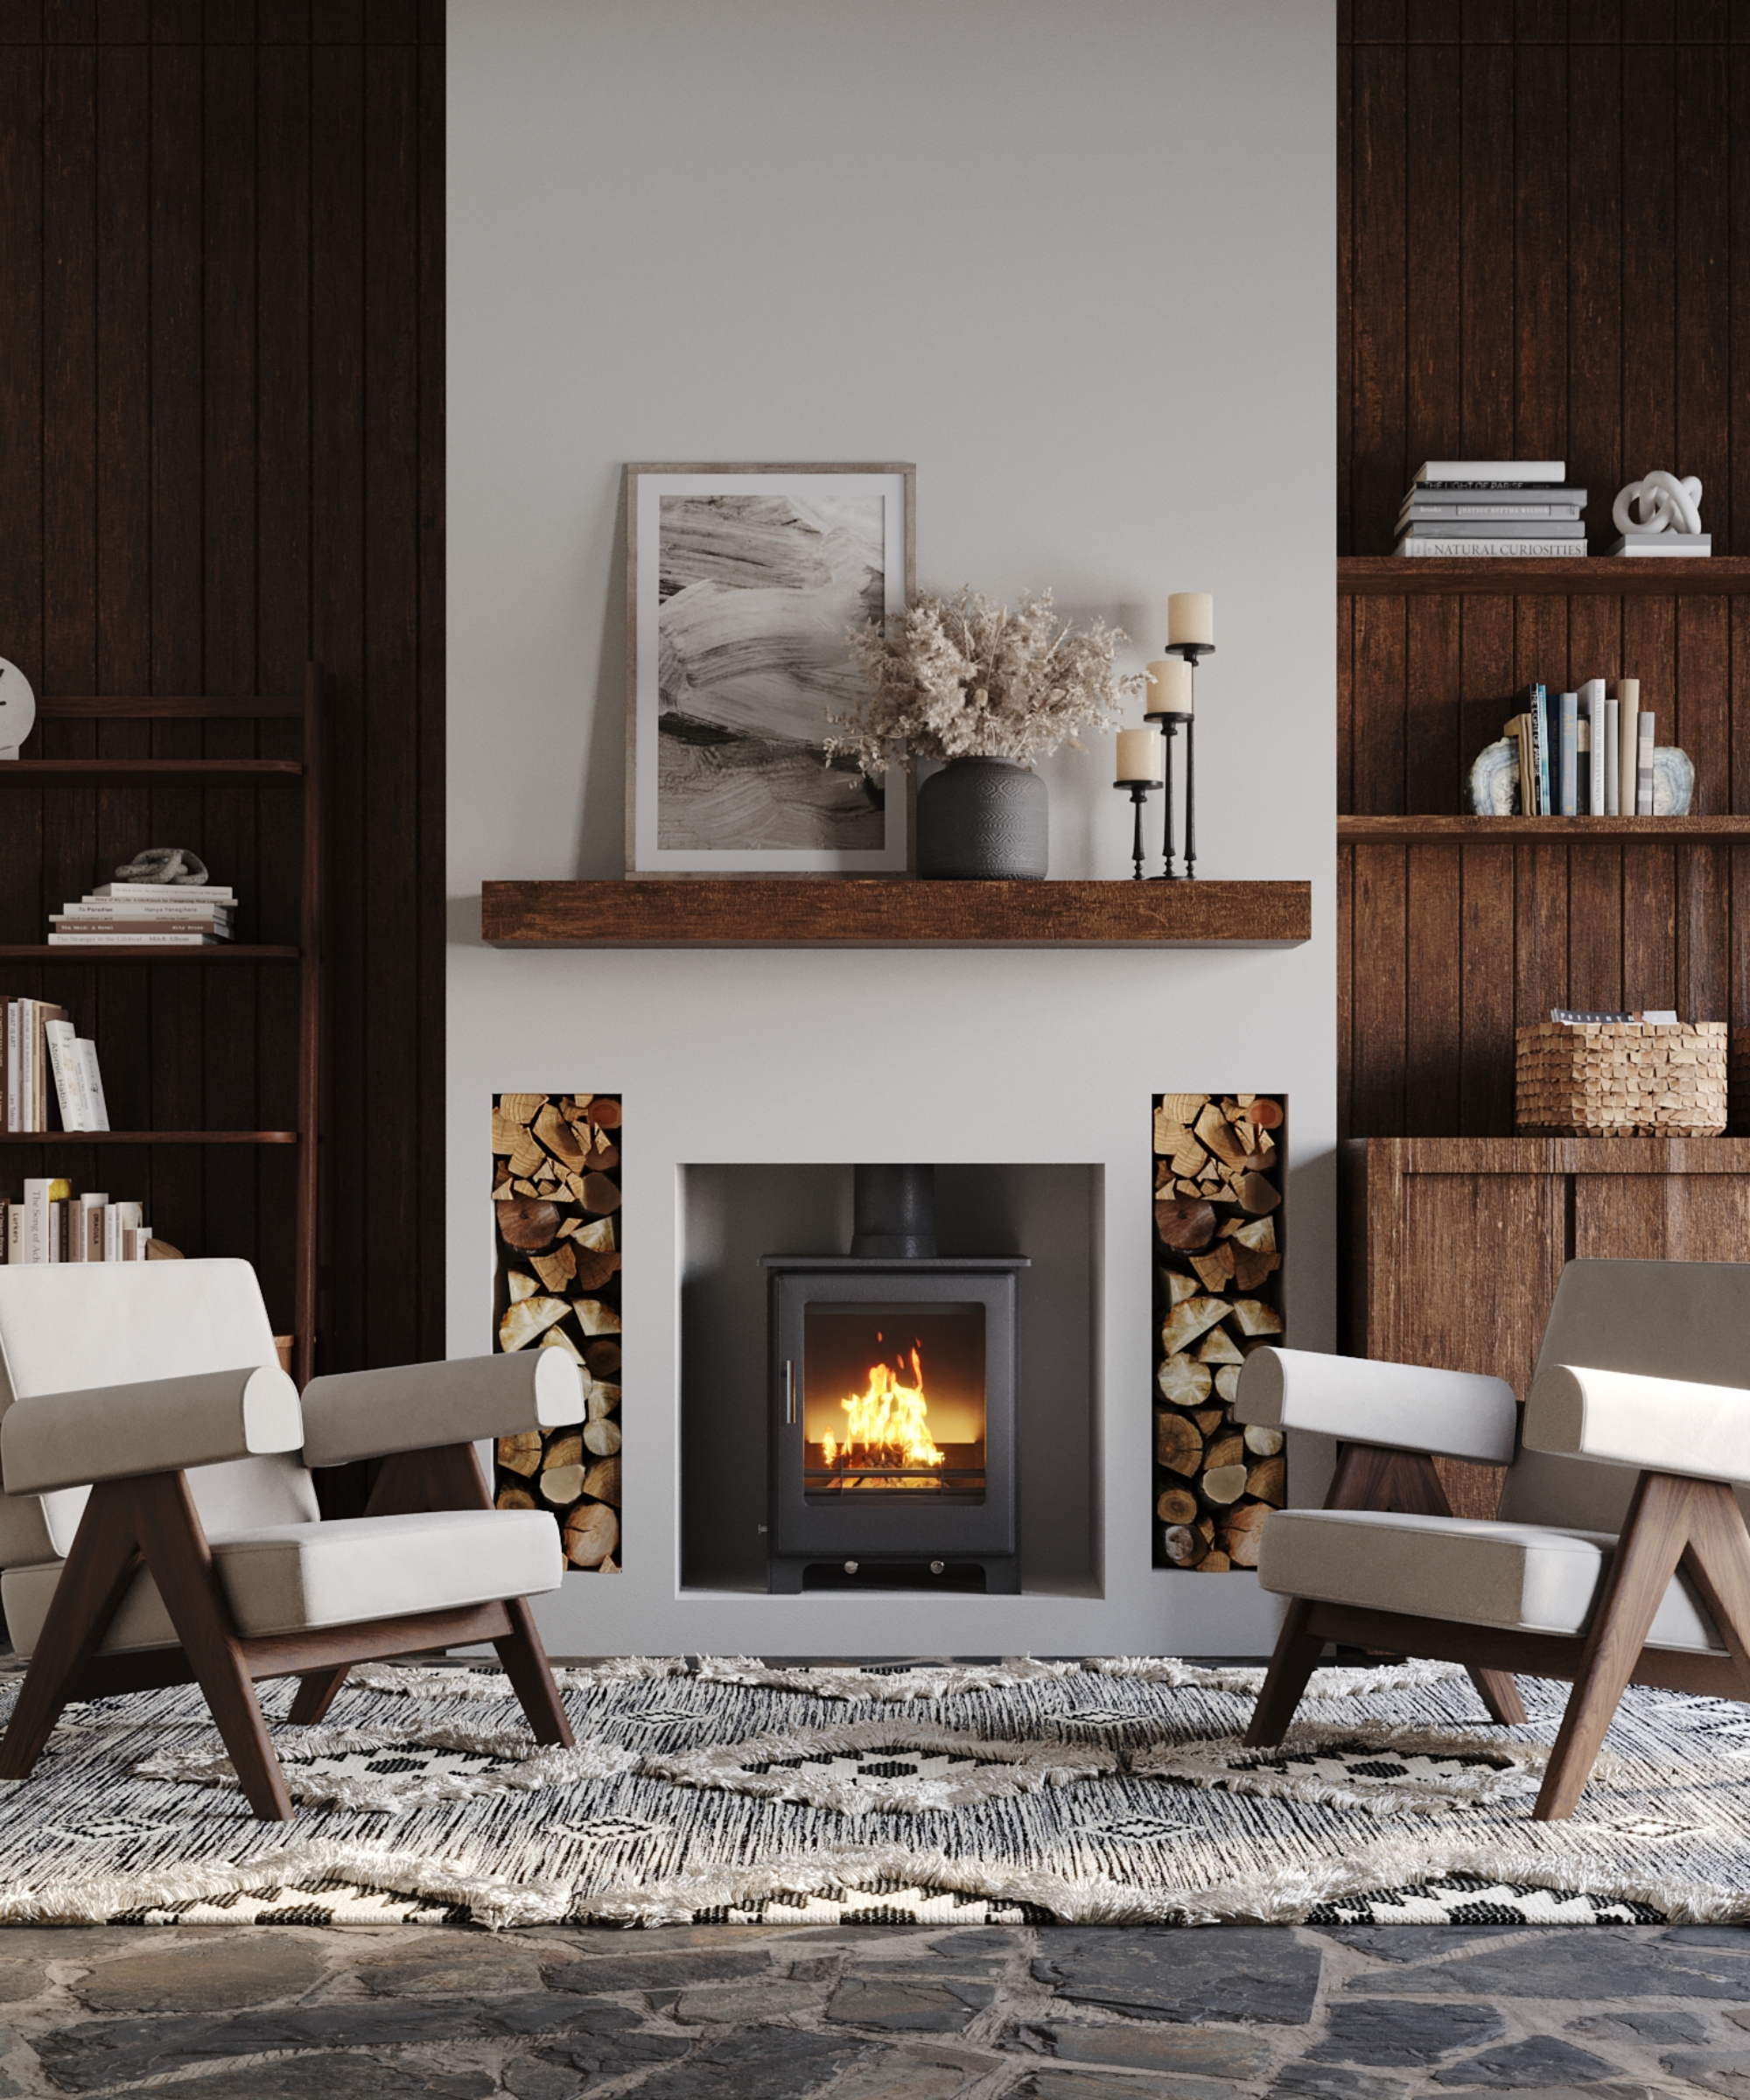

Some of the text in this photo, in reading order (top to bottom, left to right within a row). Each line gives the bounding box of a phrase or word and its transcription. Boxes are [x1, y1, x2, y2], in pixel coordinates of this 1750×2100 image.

[1434, 544, 1496, 556] NATURAL
[1500, 544, 1582, 556] CURIOSITIES
[1564, 712, 1574, 738] ART
[1533, 734, 1539, 746] OF
[51, 1042, 68, 1110] Atomic Habits
[32, 1190, 41, 1208] The
[31, 1209, 41, 1231] Song
[32, 1234, 41, 1243] of
